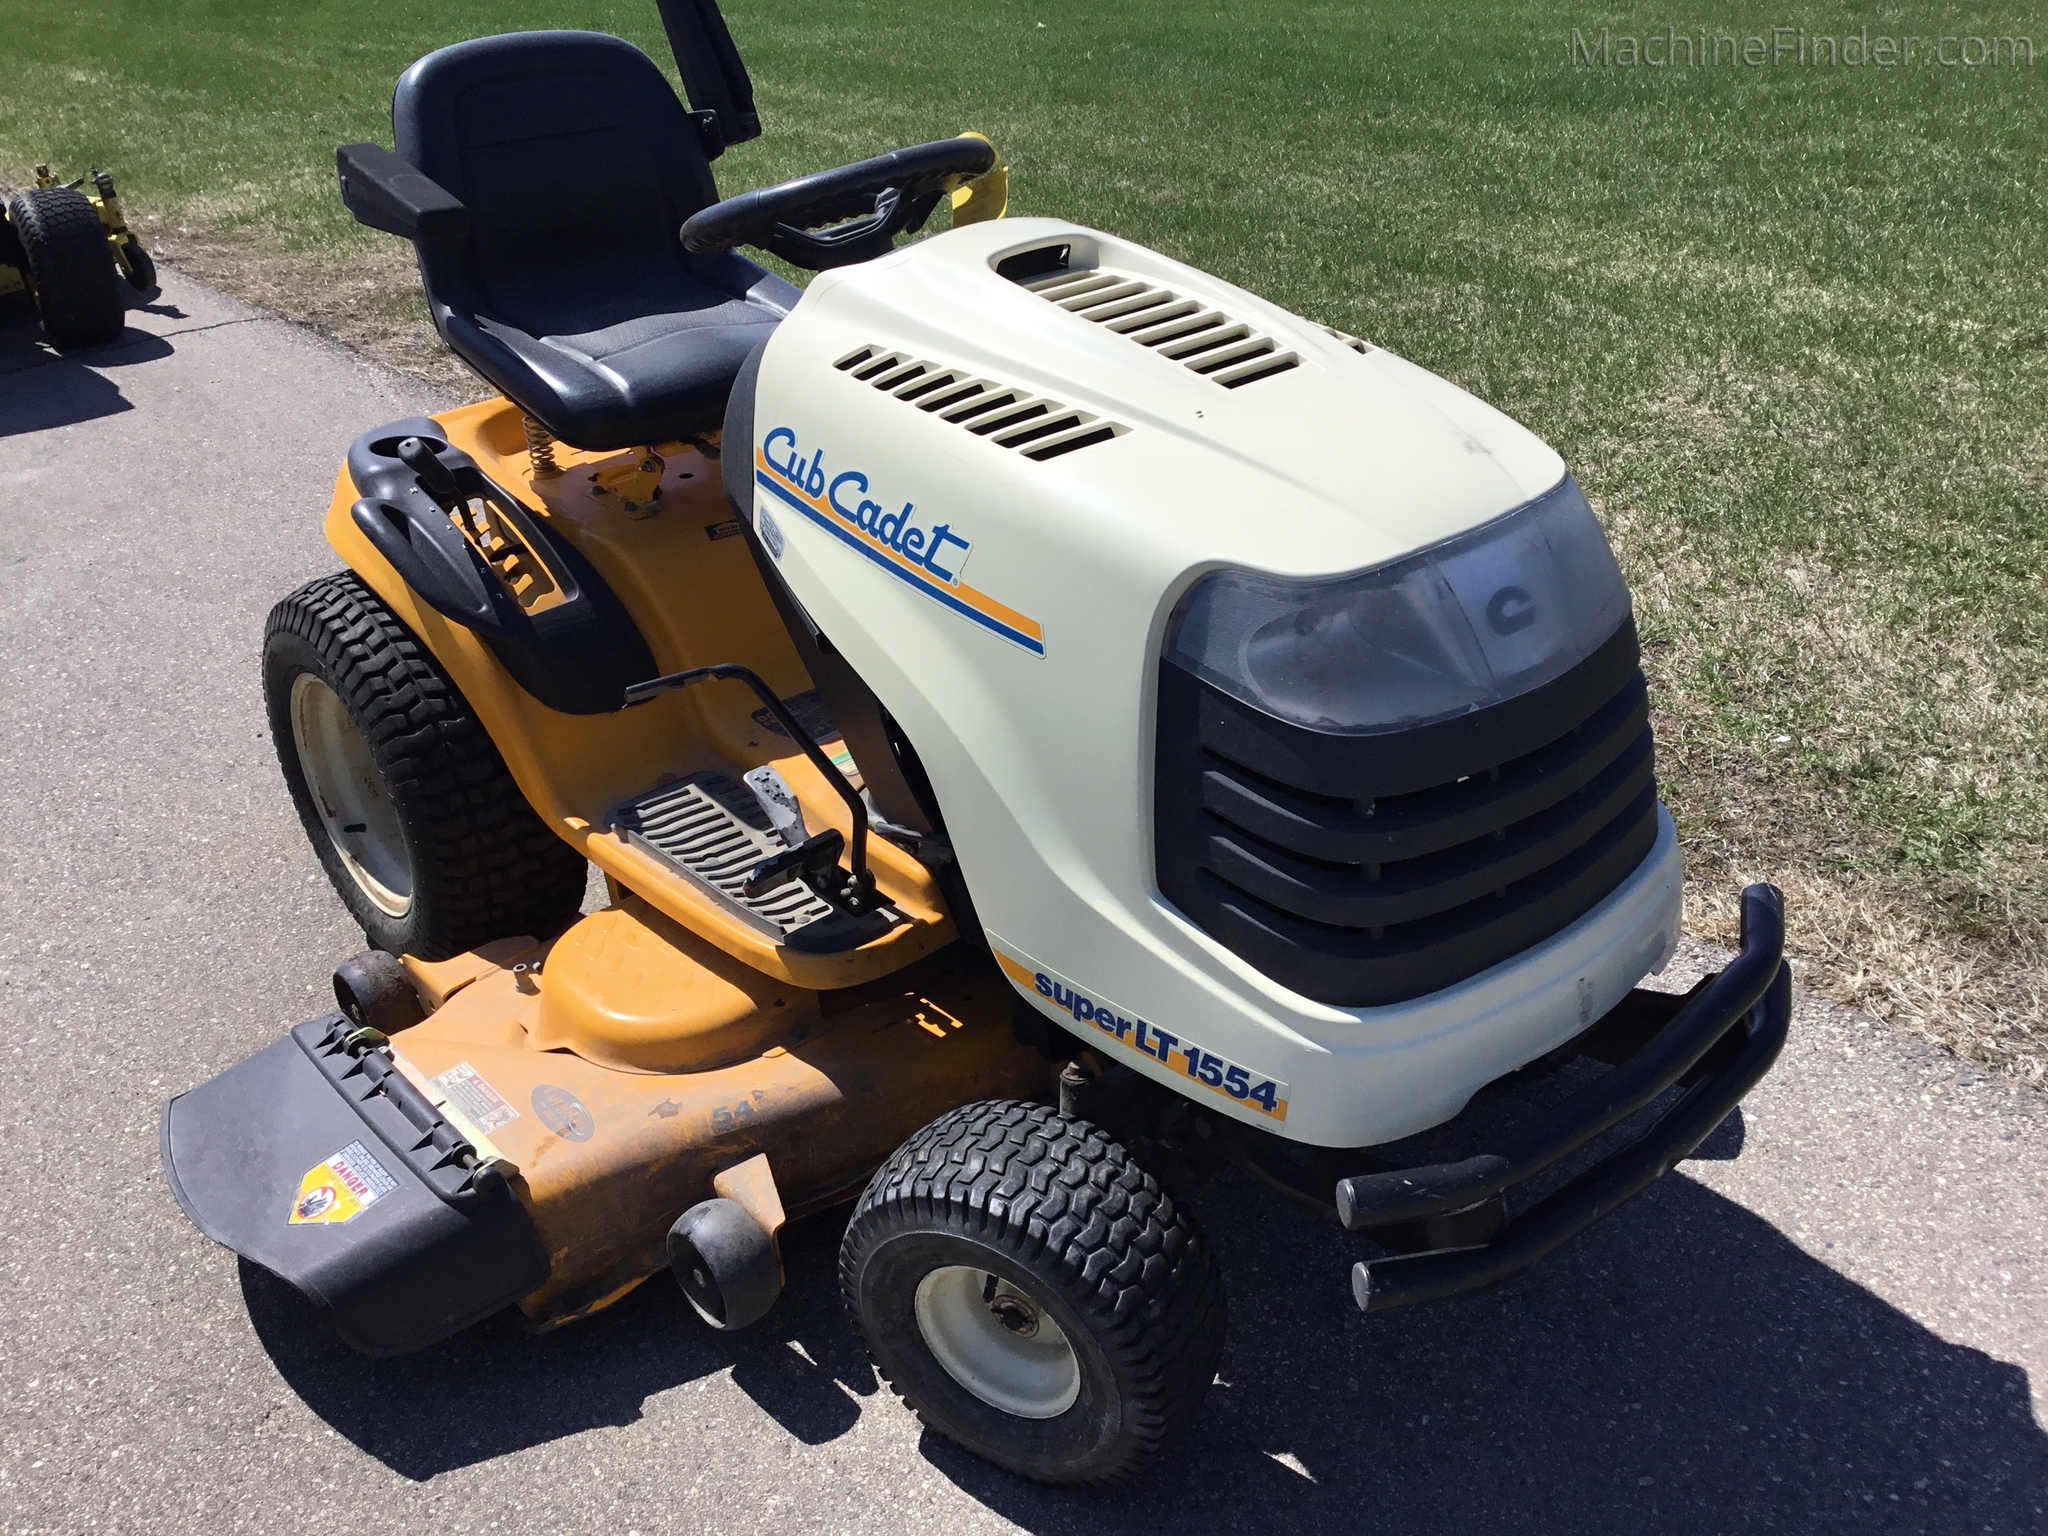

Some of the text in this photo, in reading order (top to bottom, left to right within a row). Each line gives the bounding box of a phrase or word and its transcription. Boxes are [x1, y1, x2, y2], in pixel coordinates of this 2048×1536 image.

[763, 426, 825, 499] Cub
[828, 470, 971, 583] Cadet
[477, 1083, 499, 1105] DANGER
[1183, 1046, 1278, 1113] 1554
[331, 1160, 369, 1198] DANGER
